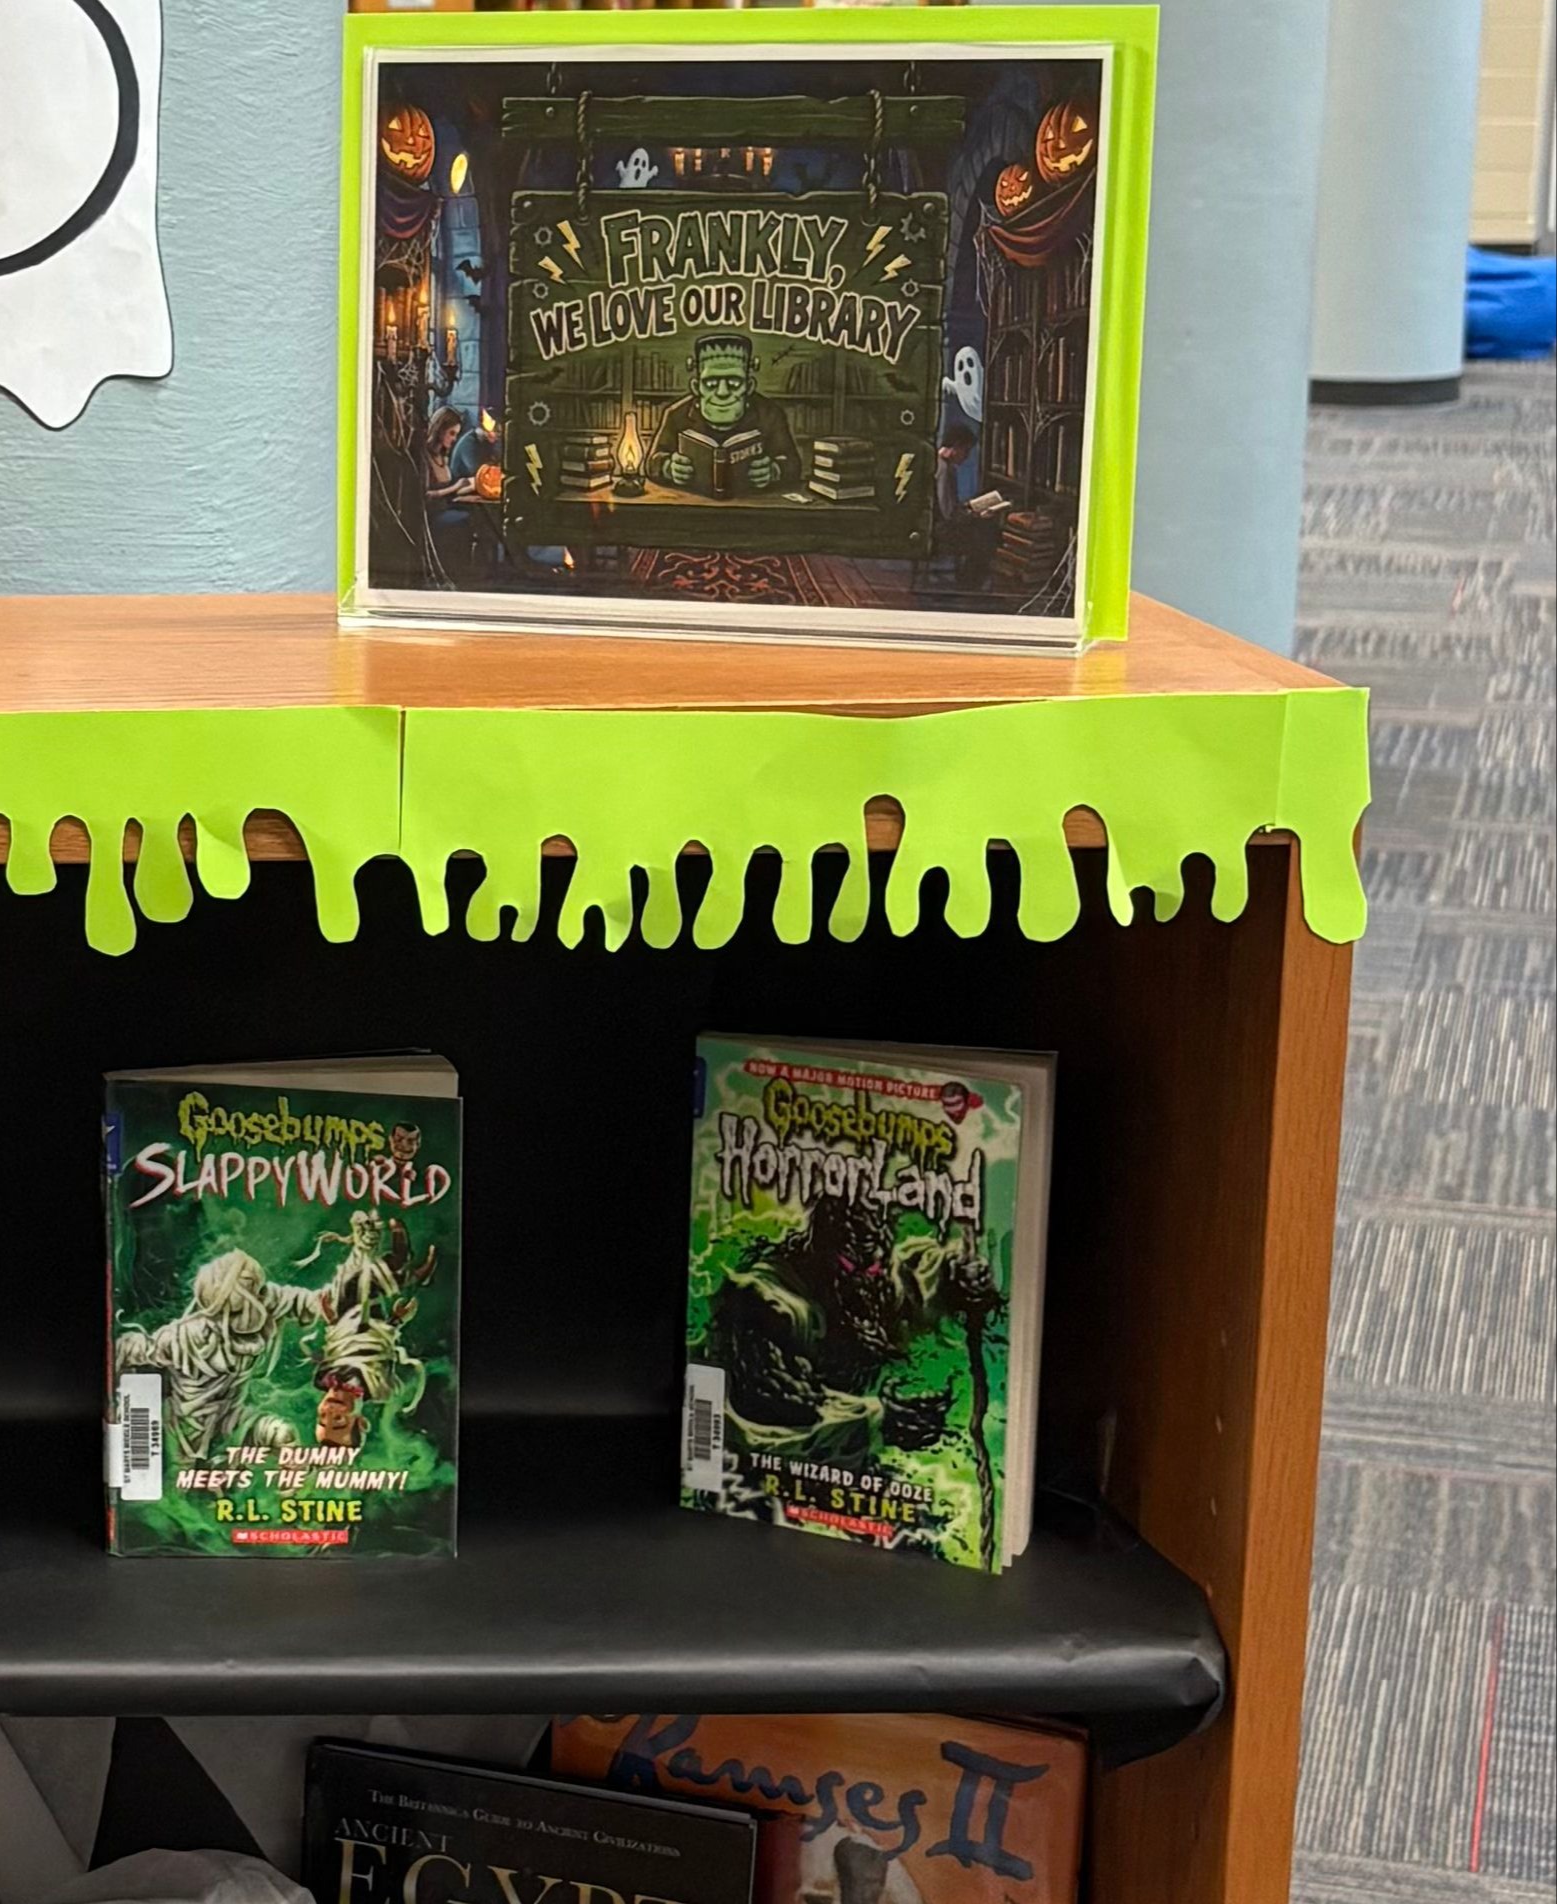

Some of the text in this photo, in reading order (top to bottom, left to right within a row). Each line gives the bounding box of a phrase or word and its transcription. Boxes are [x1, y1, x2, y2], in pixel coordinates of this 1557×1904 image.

[600, 209, 849, 290] FRANKLY,
[529, 279, 922, 365] WE LOVE OUR LIBRARY
[748, 1061, 937, 1100] NOW A MAJOR MOTION PICTURE
[177, 1090, 386, 1164] Goosebumps
[763, 1076, 957, 1170] Goosebumps
[175, 1469, 410, 1491] MEETS THE MUMMY!
[225, 1446, 362, 1466] THE DUMMY
[749, 1452, 933, 1503] THE WIZARD OF OOZE
[216, 1499, 364, 1523] R.L. STINE
[764, 1473, 917, 1523] R.L. STINE
[249, 1530, 348, 1544] SCHOLASTIC
[334, 1817, 454, 1854] ANCIENT
[924, 1739, 1051, 1882] II
